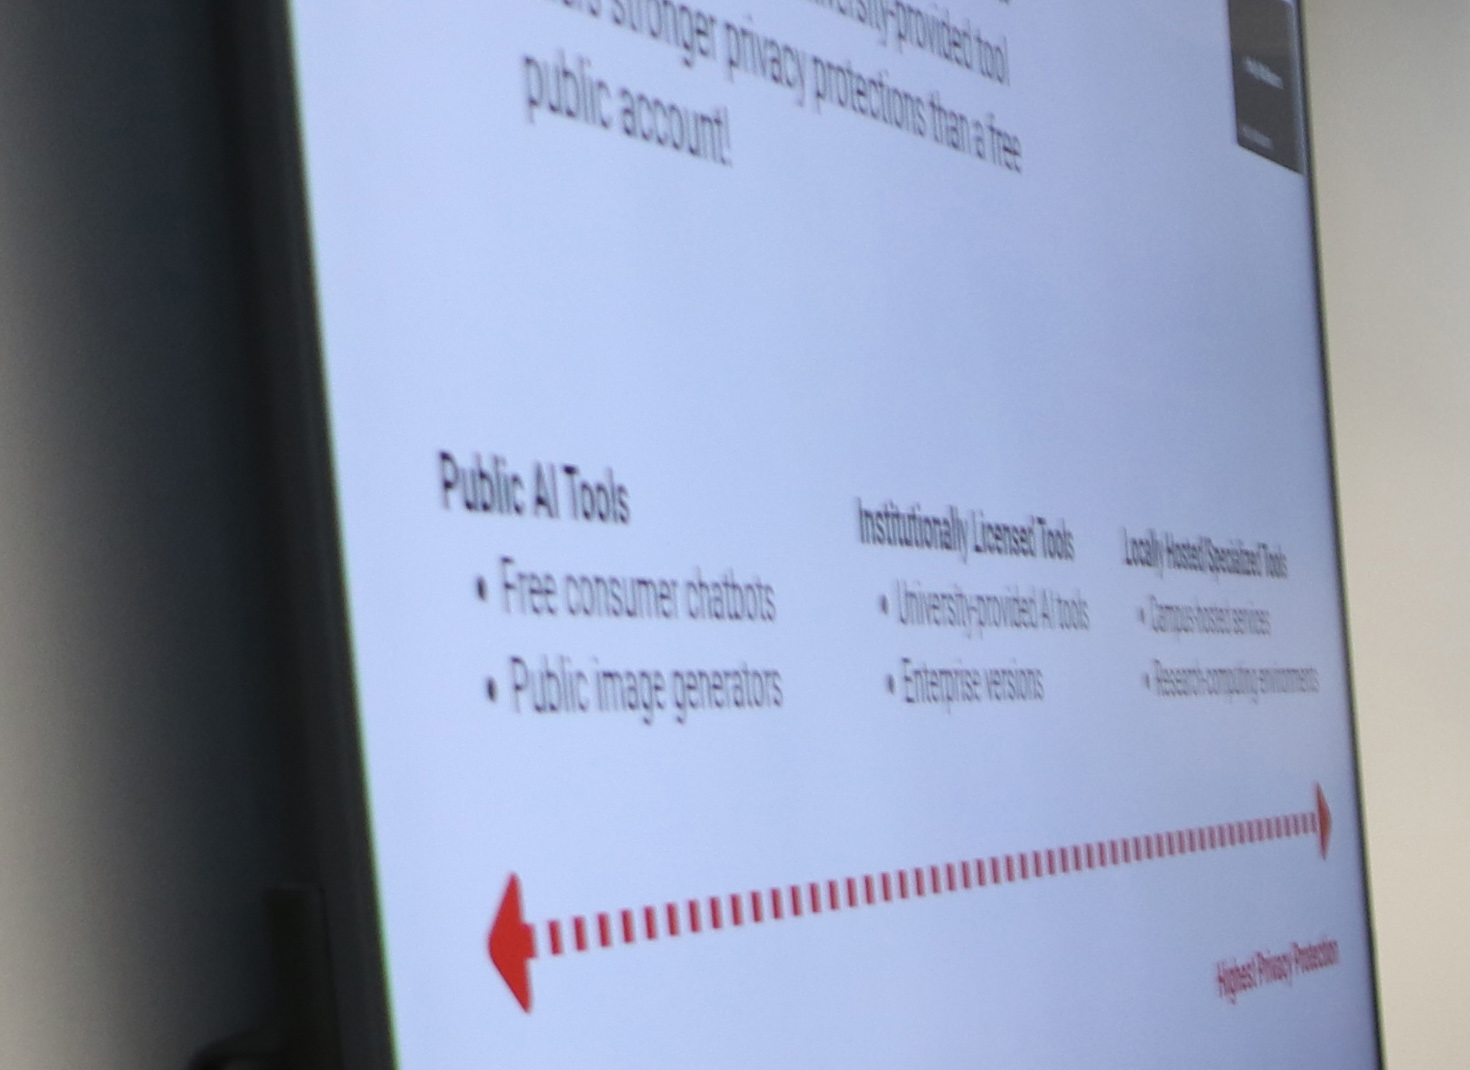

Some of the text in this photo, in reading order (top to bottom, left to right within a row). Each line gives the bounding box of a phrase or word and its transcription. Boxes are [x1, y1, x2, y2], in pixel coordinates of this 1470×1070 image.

[611, 0, 1023, 174] stronger privacy protections than a free
[974, 28, 1009, 87] tool
[523, 49, 733, 167] public account!
[438, 449, 632, 525] Public AI Tools
[857, 496, 1076, 566] Institutionally Licensed Tools
[1122, 526, 1164, 580] Locally
[501, 555, 777, 622] Free consumer chatbots
[896, 578, 1090, 640] University-provided AI tools
[510, 654, 784, 726] Public image generators
[901, 656, 1045, 715] Enterprise versions
[1217, 934, 1340, 1005] Highest Privacy Protection
